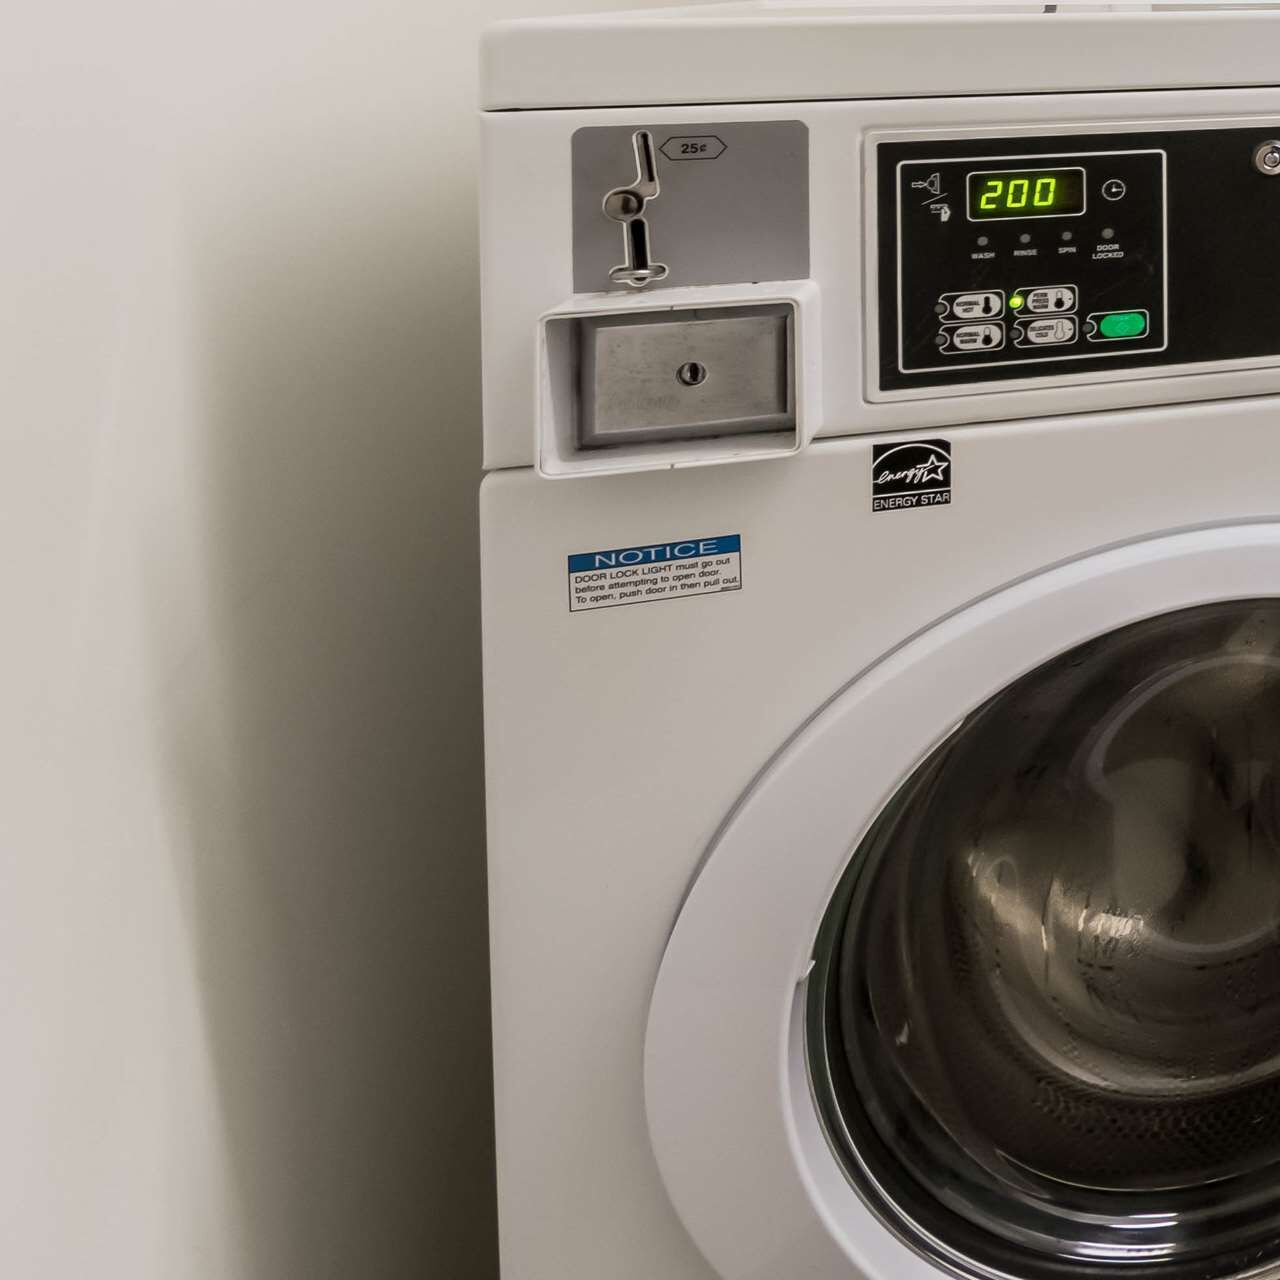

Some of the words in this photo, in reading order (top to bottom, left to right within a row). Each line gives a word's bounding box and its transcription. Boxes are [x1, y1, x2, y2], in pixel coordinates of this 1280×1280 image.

[681, 143, 707, 154] 25¢
[980, 178, 1056, 209] 200
[1013, 248, 1038, 257] RINSE
[1058, 246, 1077, 254] SPIN
[1096, 243, 1120, 252] DOOR
[971, 251, 996, 260] WASH
[1092, 251, 1124, 260] LOCKED
[955, 300, 981, 308] NORMAL
[955, 331, 981, 339] NORMAL
[873, 495, 918, 510] ENERGY
[921, 492, 950, 504] STAR
[594, 540, 718, 567] NOTICE
[575, 573, 607, 584] DOOR
[610, 569, 639, 580] LOCK
[641, 565, 672, 575] LIGHT
[675, 562, 699, 570] must
[716, 558, 730, 566] out
[575, 584, 605, 594] before
[608, 577, 658, 590] attempting
[672, 573, 696, 582] open
[698, 569, 721, 578] door.
[575, 595, 587, 604] To
[589, 593, 617, 603] open,
[620, 589, 642, 600] push
[645, 586, 666, 595] door
[669, 584, 677, 592] in
[680, 581, 700, 590] then
[703, 578, 720, 588] pull
